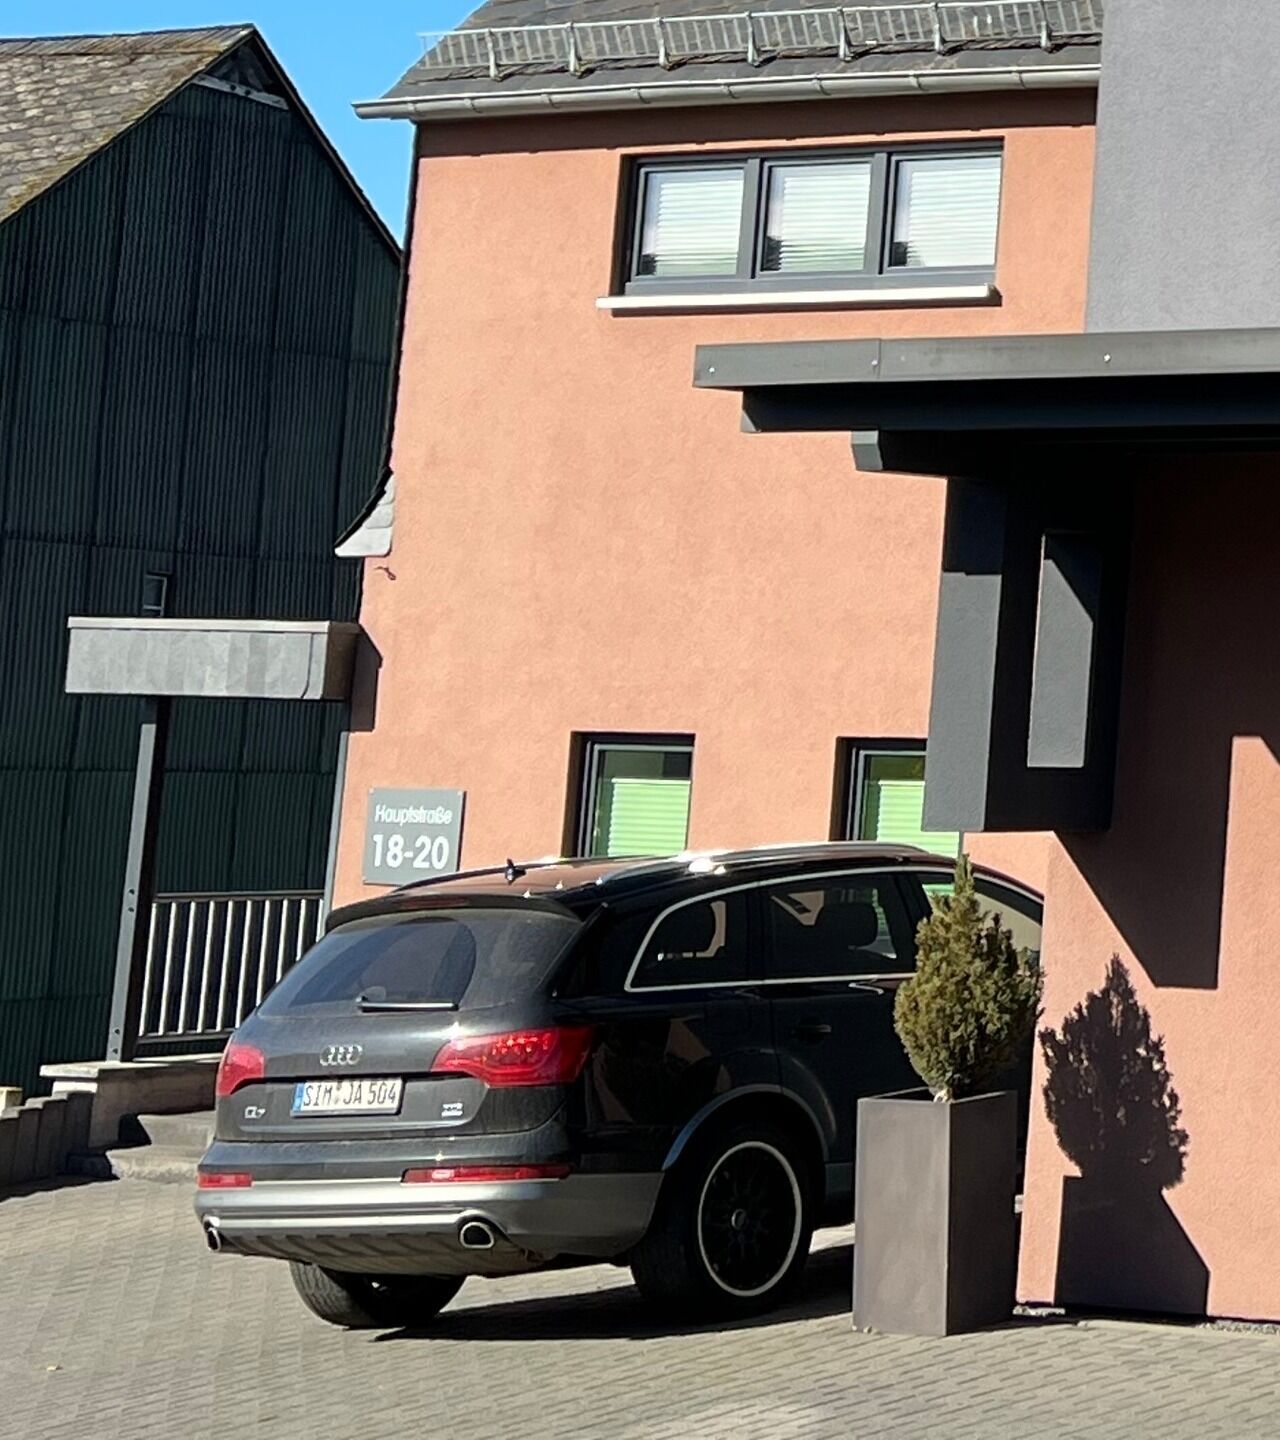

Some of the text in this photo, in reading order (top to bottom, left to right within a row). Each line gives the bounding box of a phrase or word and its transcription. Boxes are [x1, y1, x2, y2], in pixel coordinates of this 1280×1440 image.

[374, 804, 453, 827] Hauptstraße
[372, 834, 450, 870] 18-20
[303, 1081, 397, 1107] SIM JA 504
